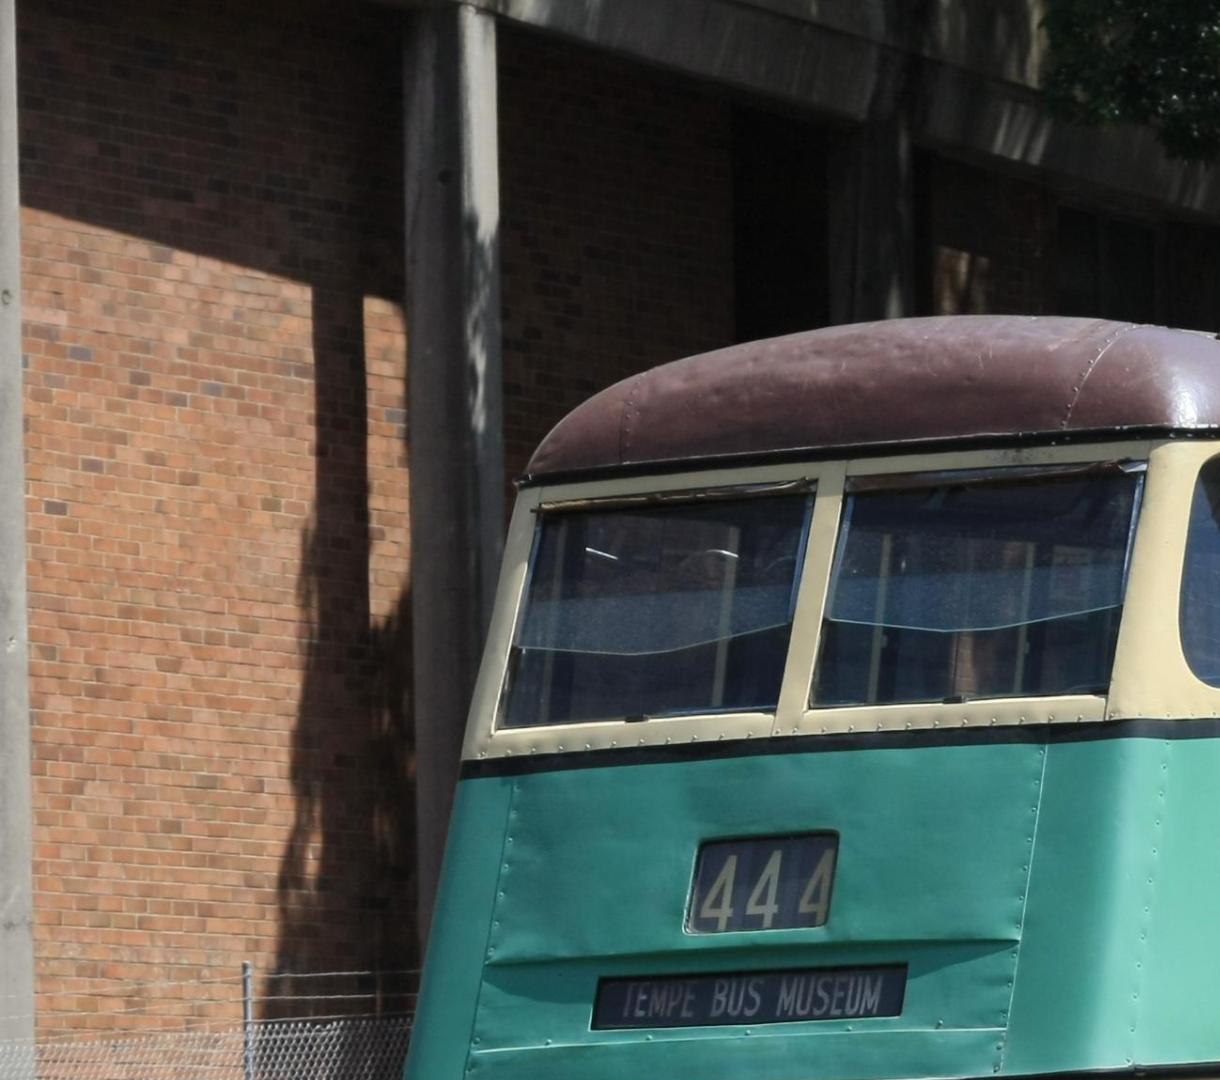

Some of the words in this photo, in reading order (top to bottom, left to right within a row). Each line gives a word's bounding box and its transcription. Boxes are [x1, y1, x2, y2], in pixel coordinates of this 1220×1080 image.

[700, 848, 835, 931] 444
[623, 981, 697, 1018] TEMPE
[710, 976, 766, 1017] BUS
[776, 974, 884, 1017] MUSEUM
